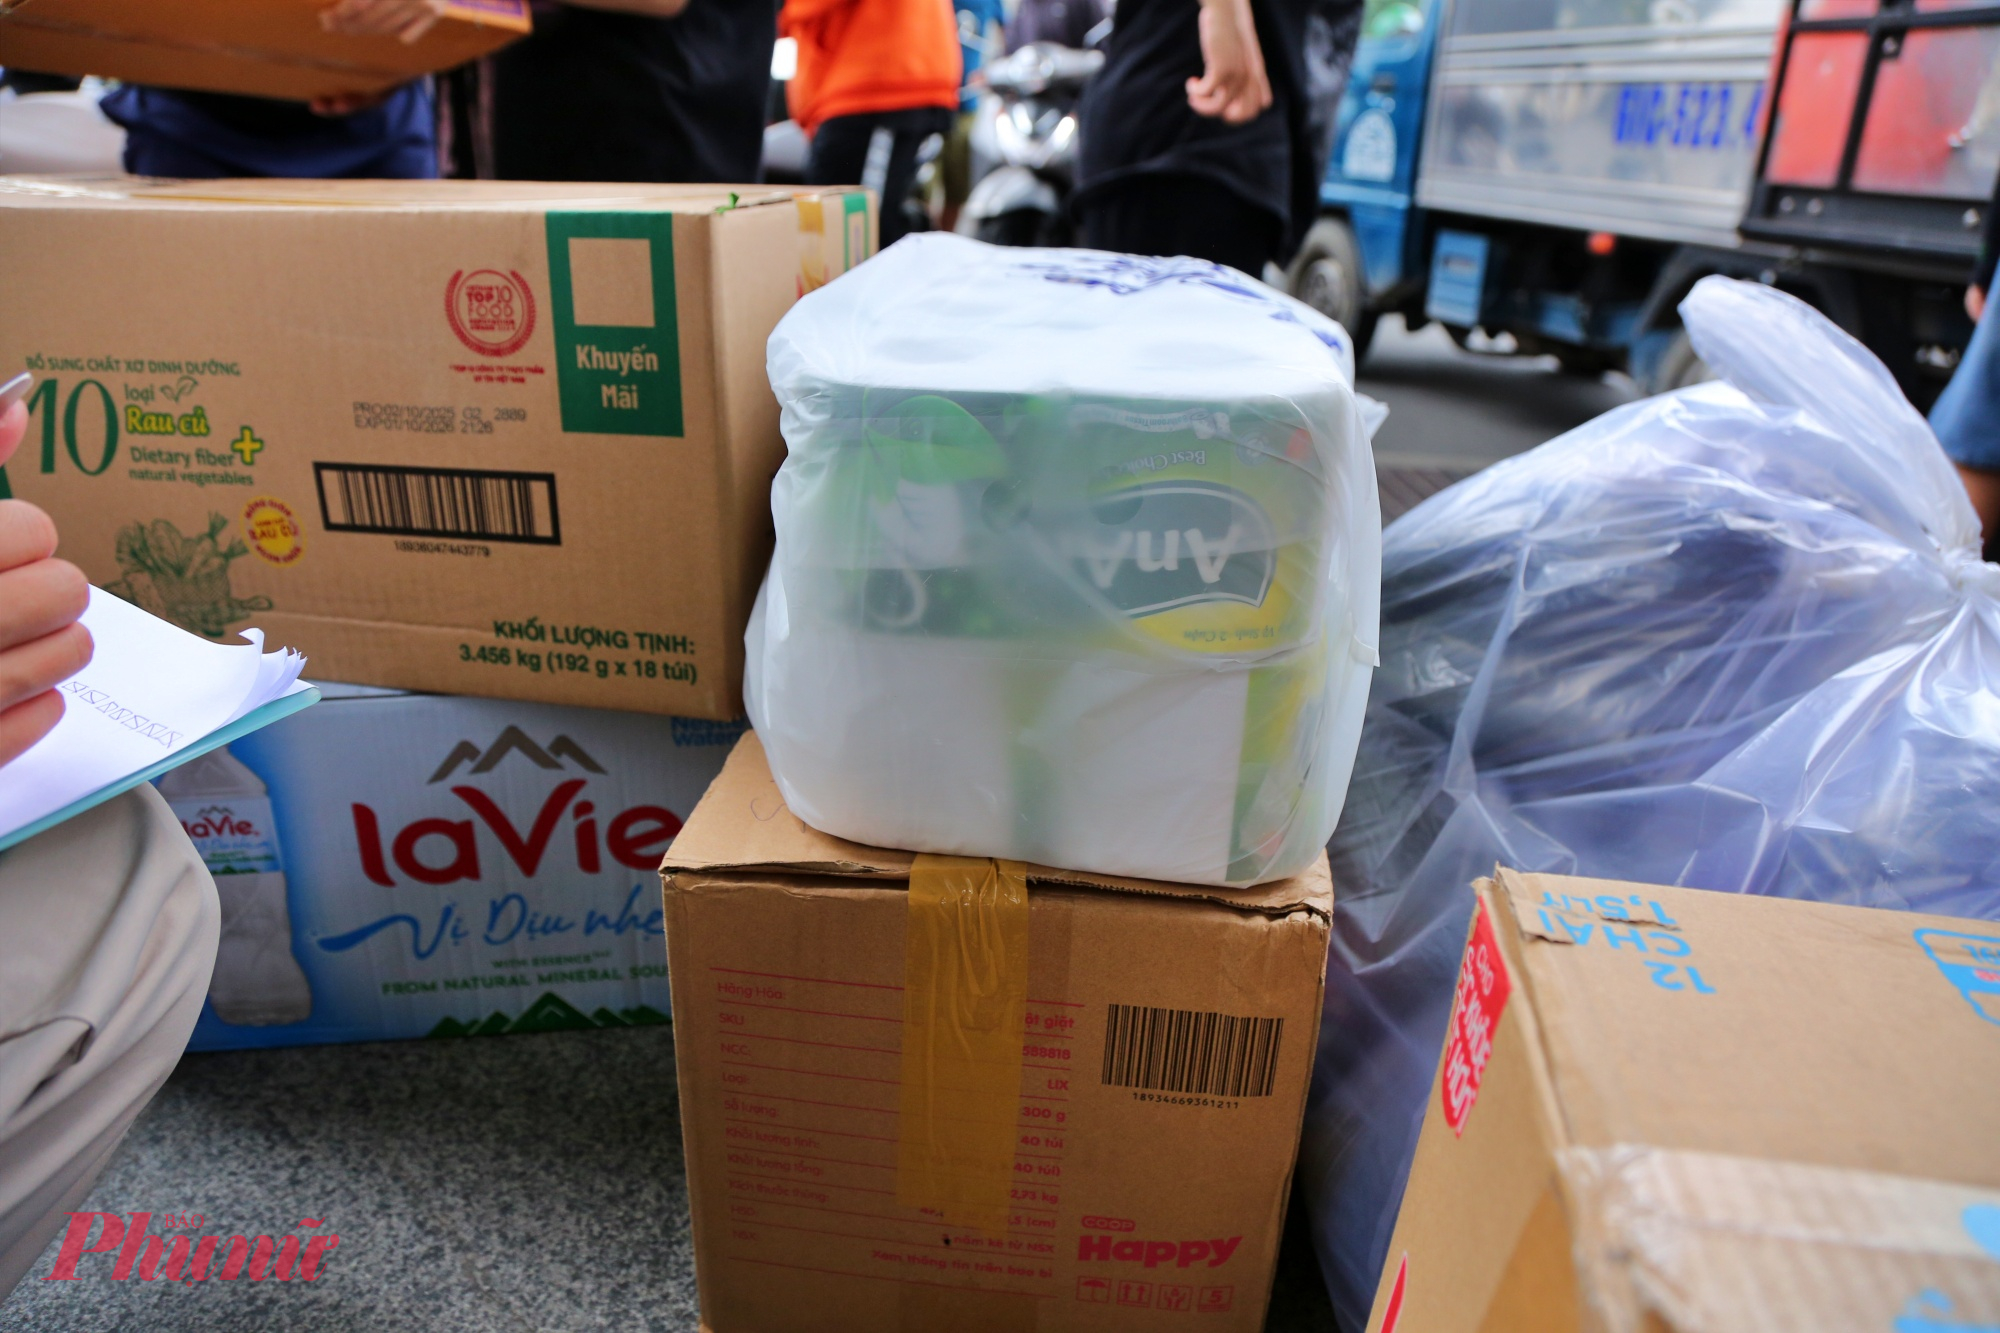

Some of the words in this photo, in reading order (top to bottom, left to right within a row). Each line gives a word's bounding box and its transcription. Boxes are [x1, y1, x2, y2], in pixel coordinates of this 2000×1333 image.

[47, 357, 84, 372] SUNG
[87, 355, 121, 373] CHẤT
[148, 360, 182, 374] DINH
[186, 358, 241, 377] DƯỠNG
[575, 344, 659, 376] Khuyến
[124, 383, 155, 405] loại
[601, 384, 639, 410] Mãi
[28, 377, 119, 476] 10
[125, 404, 175, 435] Rau
[178, 404, 210, 436] củ
[130, 446, 191, 468] Dietary
[196, 448, 236, 468] fiber
[1171, 449, 1207, 466] Best
[129, 468, 176, 483] natural
[180, 469, 254, 487] vegetables
[493, 616, 546, 642] KHỐI
[552, 624, 629, 650] LƯỢNG
[634, 632, 696, 656] TỊNH:
[459, 643, 511, 666] 3.456
[516, 648, 541, 673] kg
[547, 650, 589, 674] (192
[596, 657, 608, 679] g
[615, 660, 627, 676] x
[634, 660, 657, 679] 18
[663, 662, 698, 686] túi)
[352, 779, 685, 888] laVie
[317, 900, 469, 960] Vị
[483, 892, 578, 948] Dịu
[1537, 909, 1693, 958] CHAI
[381, 980, 438, 996] FROM
[443, 973, 530, 992] NATURAL
[537, 966, 623, 985] MINERAL
[629, 962, 668, 980] SOU
[1643, 961, 1717, 995] 12
[717, 982, 753, 999] Hàng
[1044, 1014, 1075, 1032] giặt
[1047, 1079, 1069, 1091] LIX
[1132, 1092, 1240, 1109] 18934669361211
[1022, 1106, 1052, 1119] 300
[1056, 1111, 1066, 1123] g
[1020, 1134, 1041, 1147] 40
[1045, 1136, 1064, 1149] túi
[1013, 1162, 1034, 1174] 40
[1038, 1163, 1062, 1177] túi)
[1009, 1187, 1037, 1201] 2,73
[1042, 1191, 1060, 1205] kg
[1026, 1216, 1057, 1229] (cm)
[1077, 1235, 1243, 1268] Happy
[872, 1250, 903, 1263] Xem
[907, 1254, 947, 1270] thông
[952, 1259, 970, 1271] tin
[975, 1261, 1003, 1274] trên
[1007, 1265, 1035, 1278] bao
